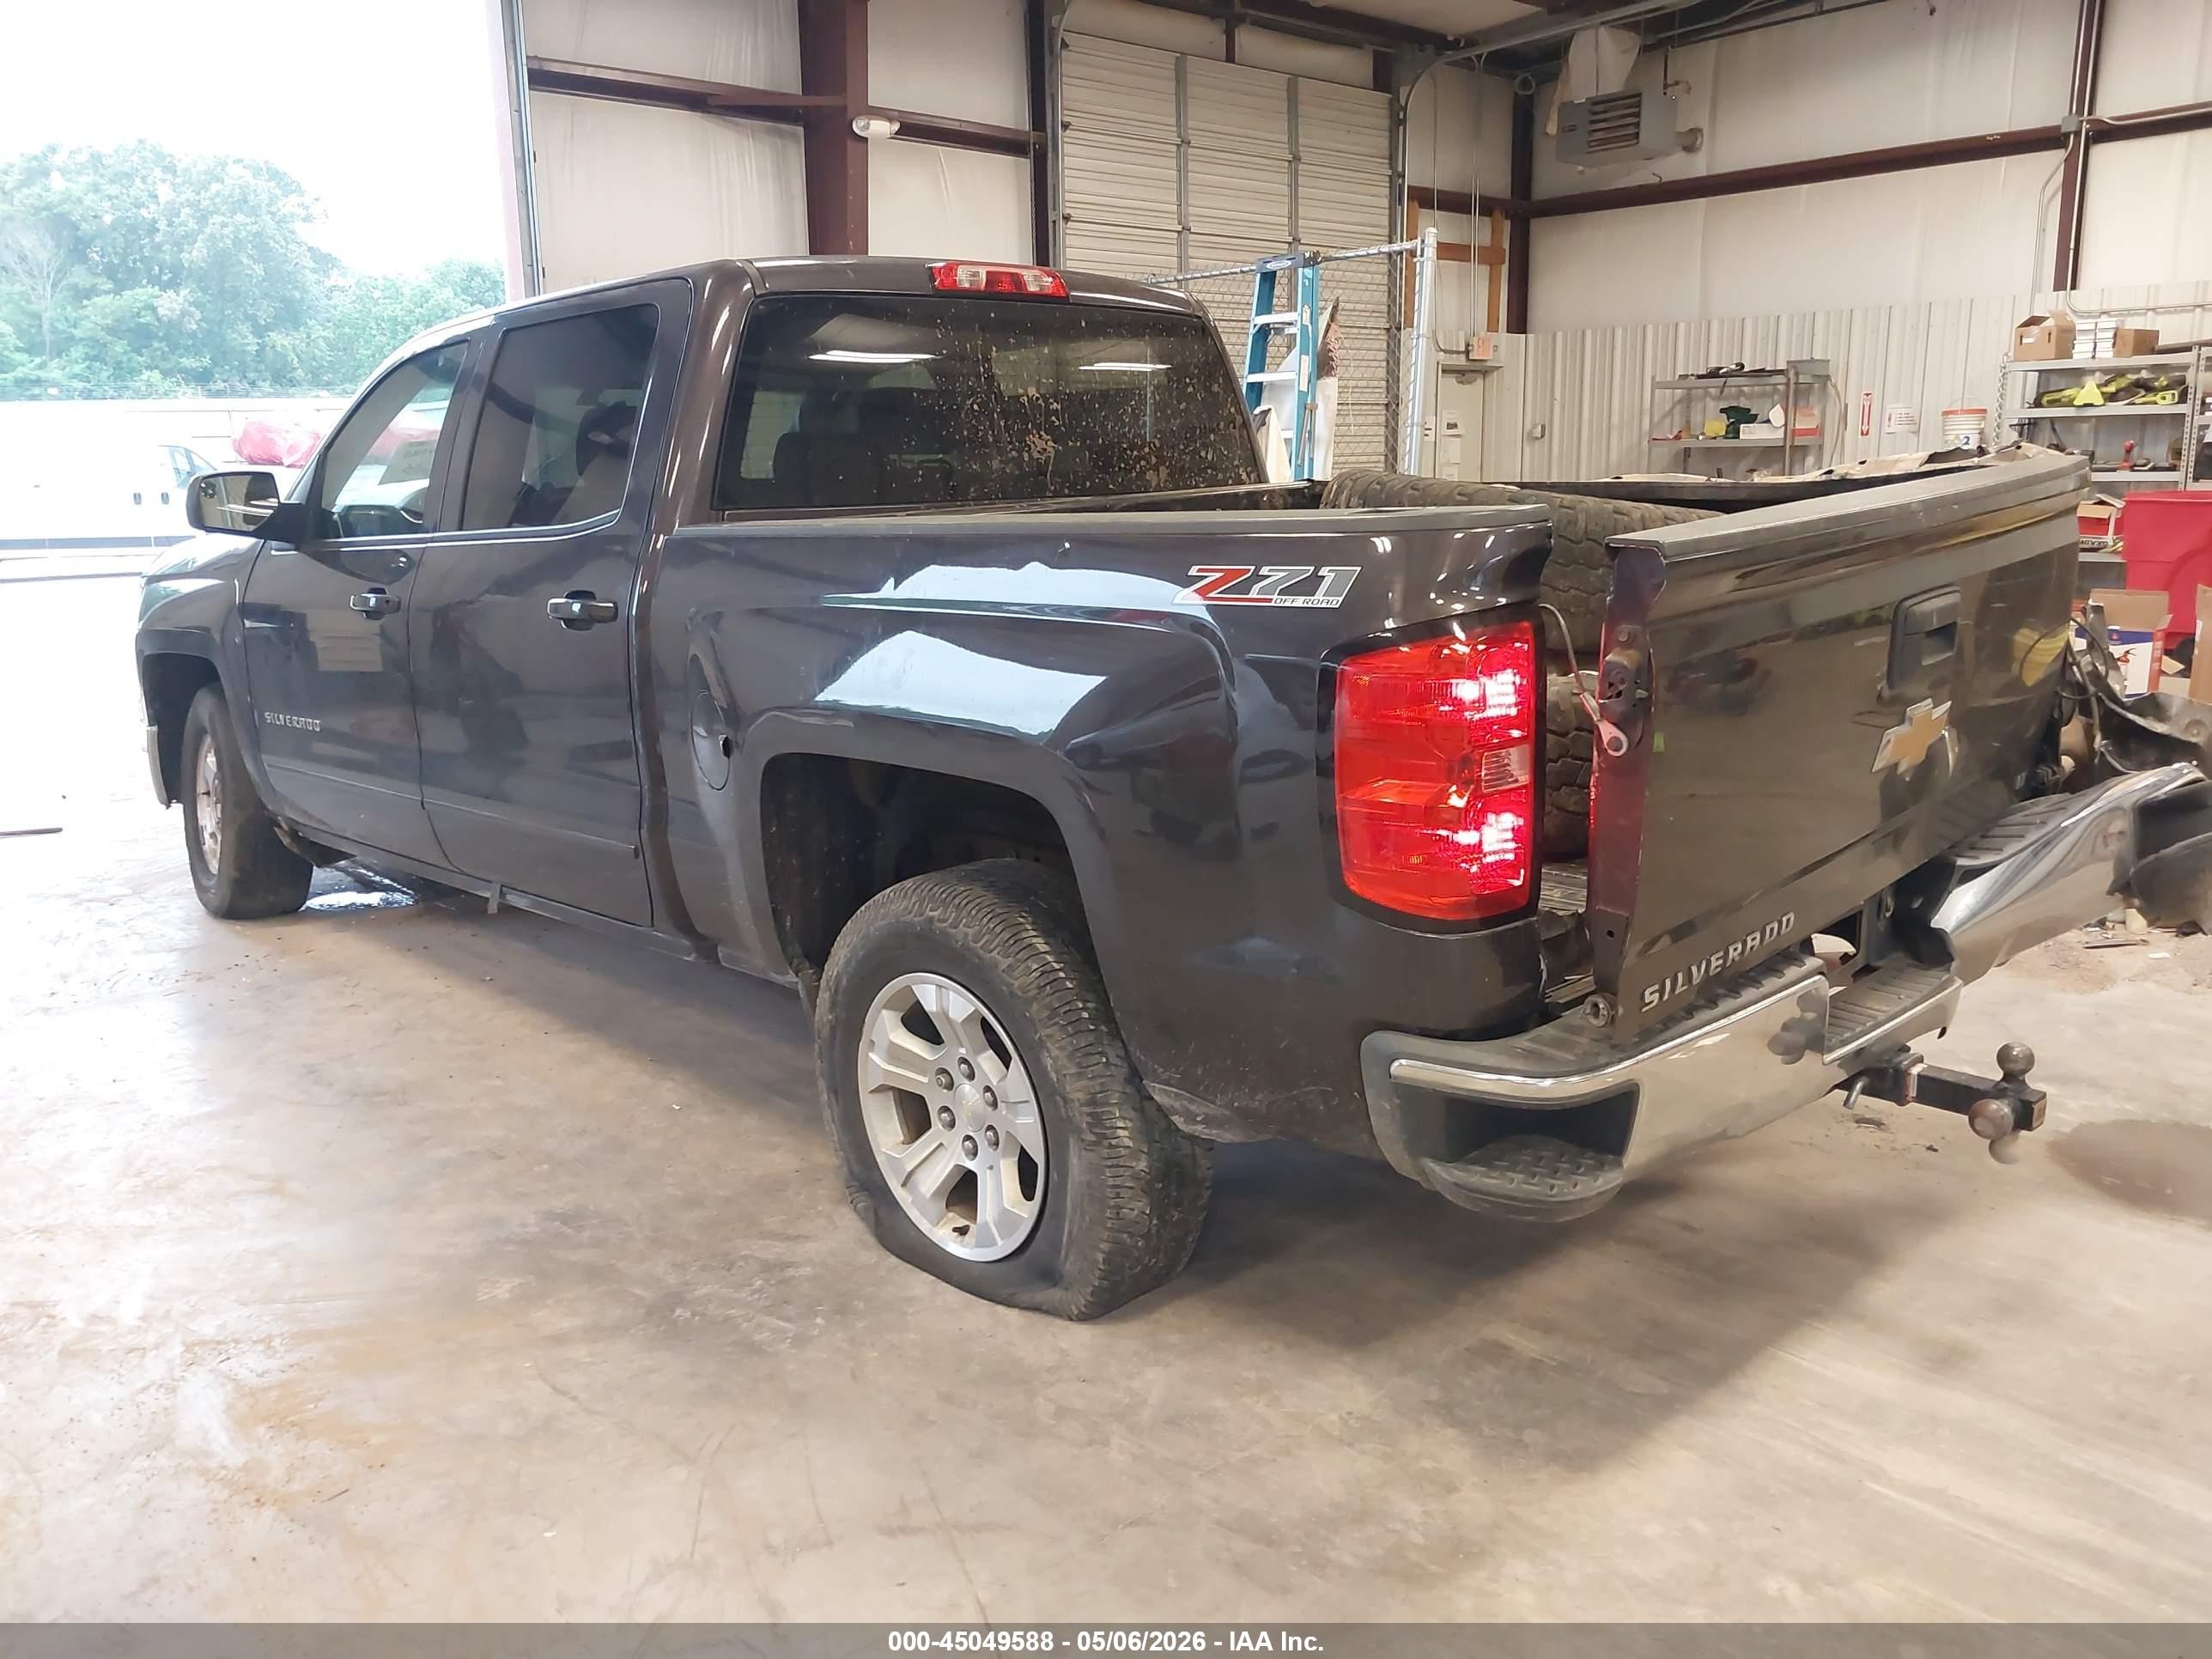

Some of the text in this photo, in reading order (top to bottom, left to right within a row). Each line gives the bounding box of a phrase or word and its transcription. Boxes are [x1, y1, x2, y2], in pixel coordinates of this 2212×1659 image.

[1173, 564, 1363, 606] Z71
[1274, 598, 1340, 606] OFF ROAD
[264, 711, 322, 732] SILVERADO
[1641, 911, 1796, 1012] SILVERADO
